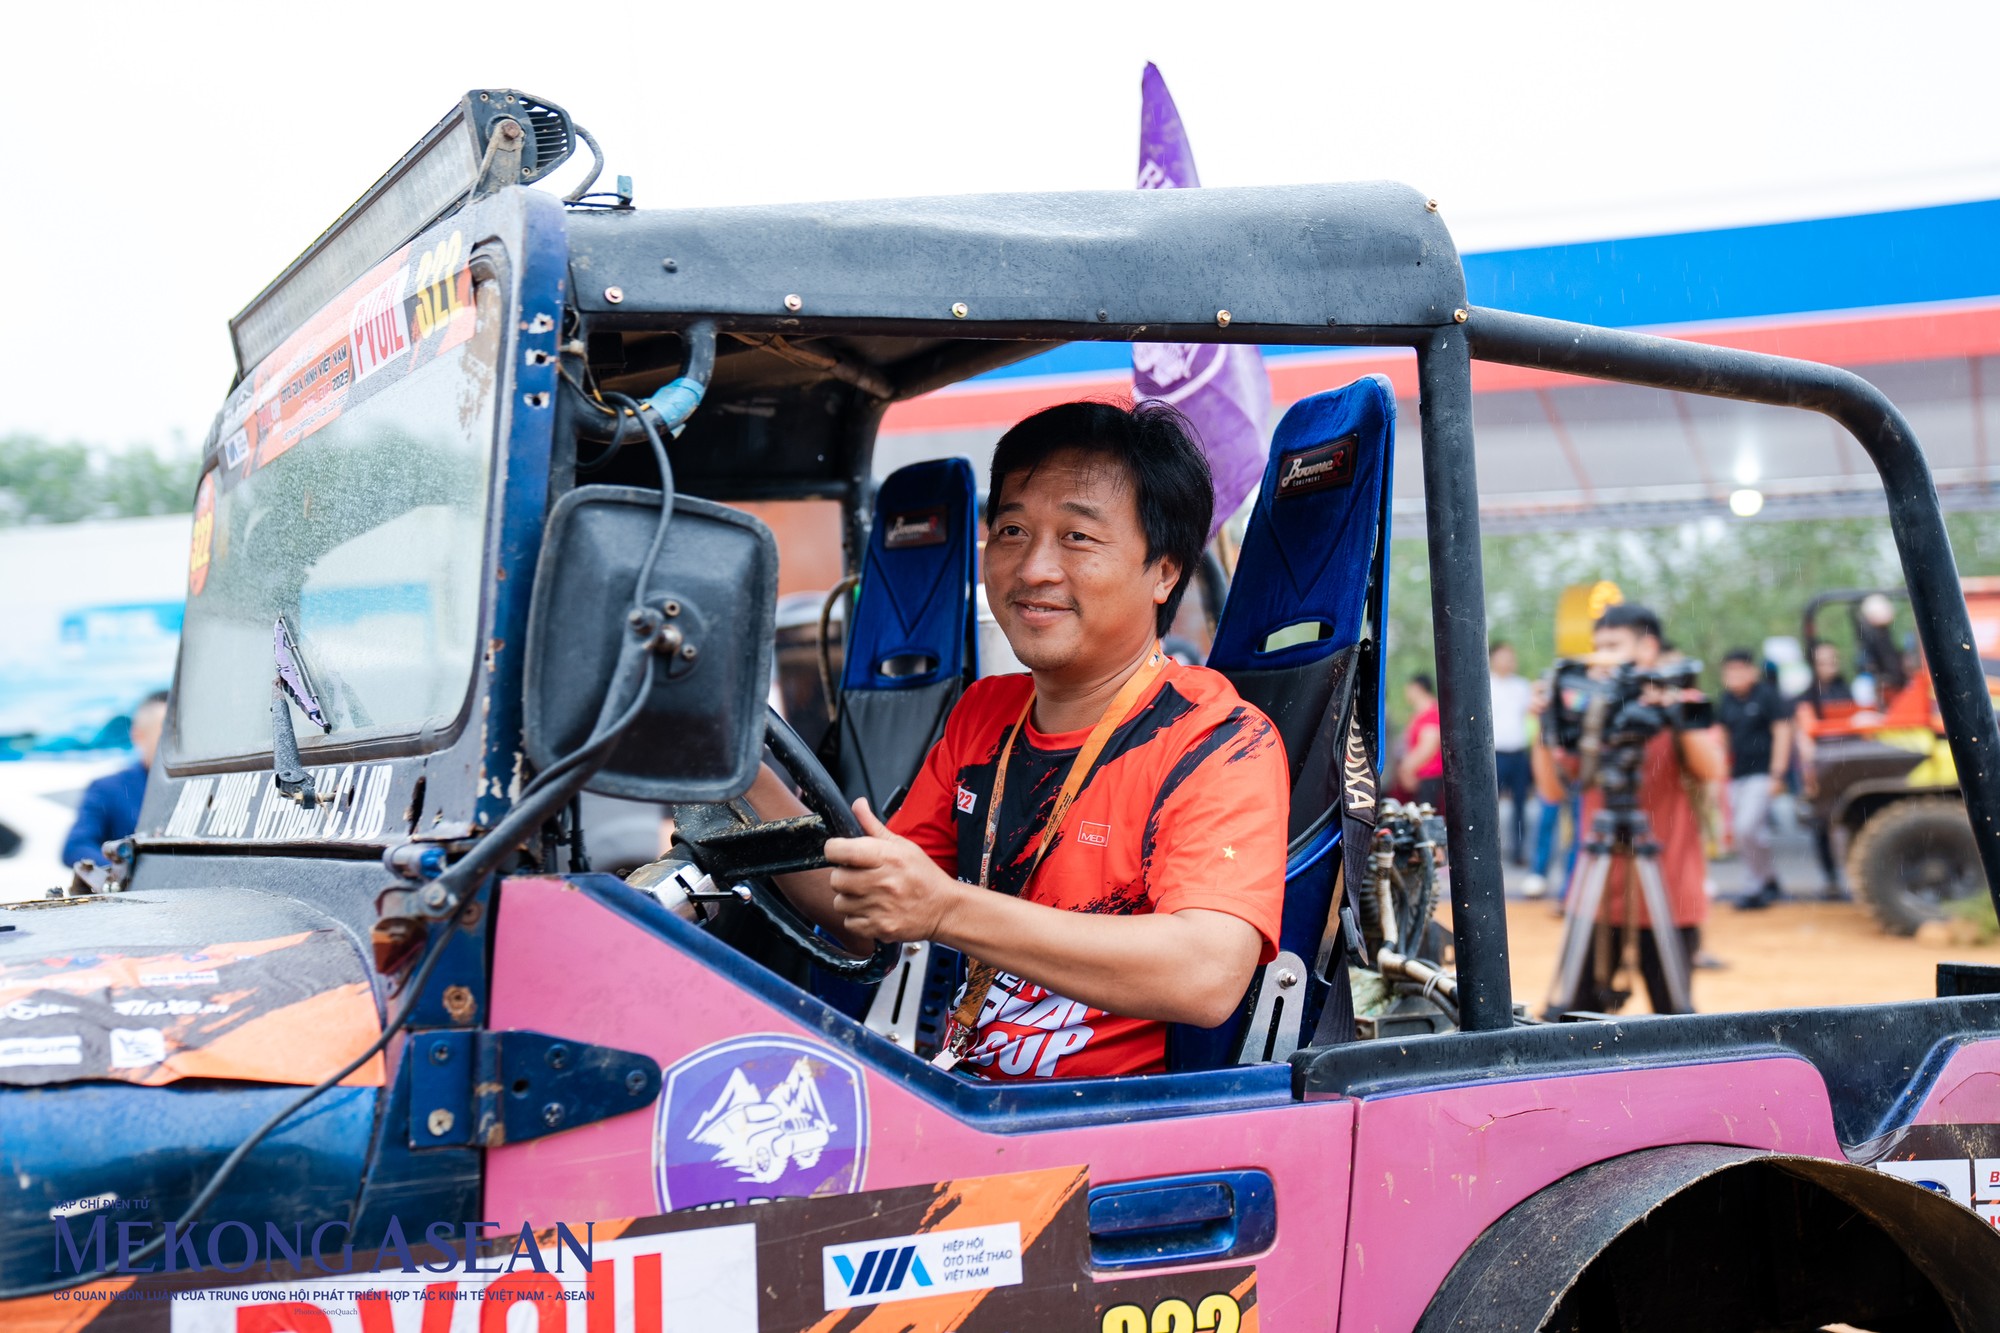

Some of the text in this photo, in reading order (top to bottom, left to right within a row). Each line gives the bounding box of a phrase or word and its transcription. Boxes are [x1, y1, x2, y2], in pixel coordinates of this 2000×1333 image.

[354, 277, 404, 375] PVOIL
[332, 343, 348, 367] NAM
[332, 368, 349, 392] 2023
[322, 764, 393, 840] CLUB
[964, 1025, 1095, 1077] CUP
[943, 1255, 964, 1268] ÔTÔ
[967, 1266, 989, 1278] NAM
